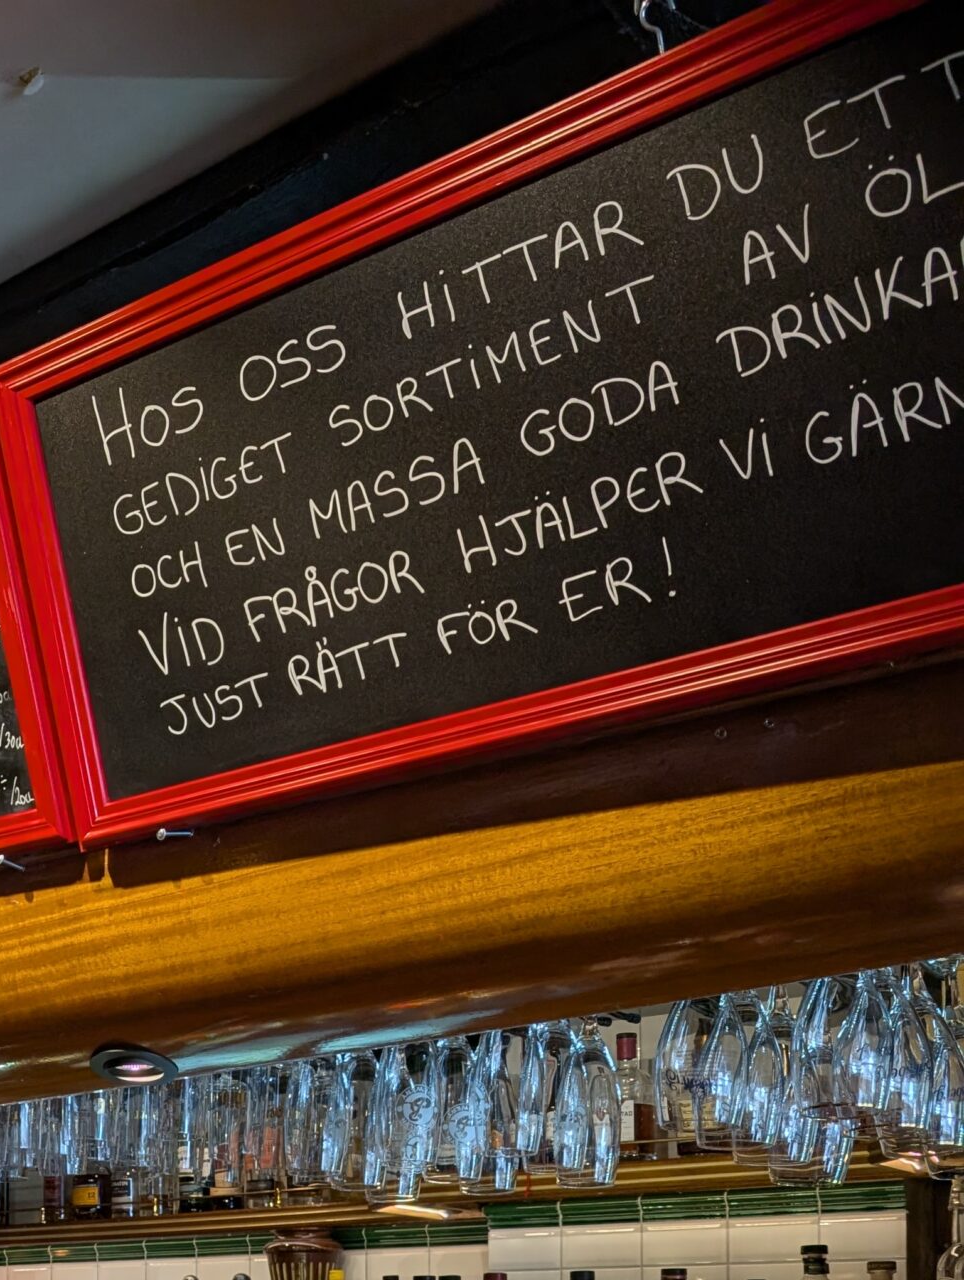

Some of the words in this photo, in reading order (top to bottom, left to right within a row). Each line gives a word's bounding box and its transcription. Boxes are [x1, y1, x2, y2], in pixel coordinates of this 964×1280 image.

[239, 325, 347, 401] OSS
[665, 133, 764, 221] DU
[743, 204, 812, 285] AV
[865, 152, 964, 219] ÖL
[130, 542, 209, 599] OCH
[224, 517, 286, 568] EN
[308, 437, 487, 543] MASSA
[519, 359, 682, 459] GODA
[245, 549, 426, 644] FRÅGOR
[456, 451, 706, 575] HJÄLPER
[158, 671, 270, 736] JUST
[287, 632, 408, 692] RÄTT
[435, 598, 539, 656] FÖR
